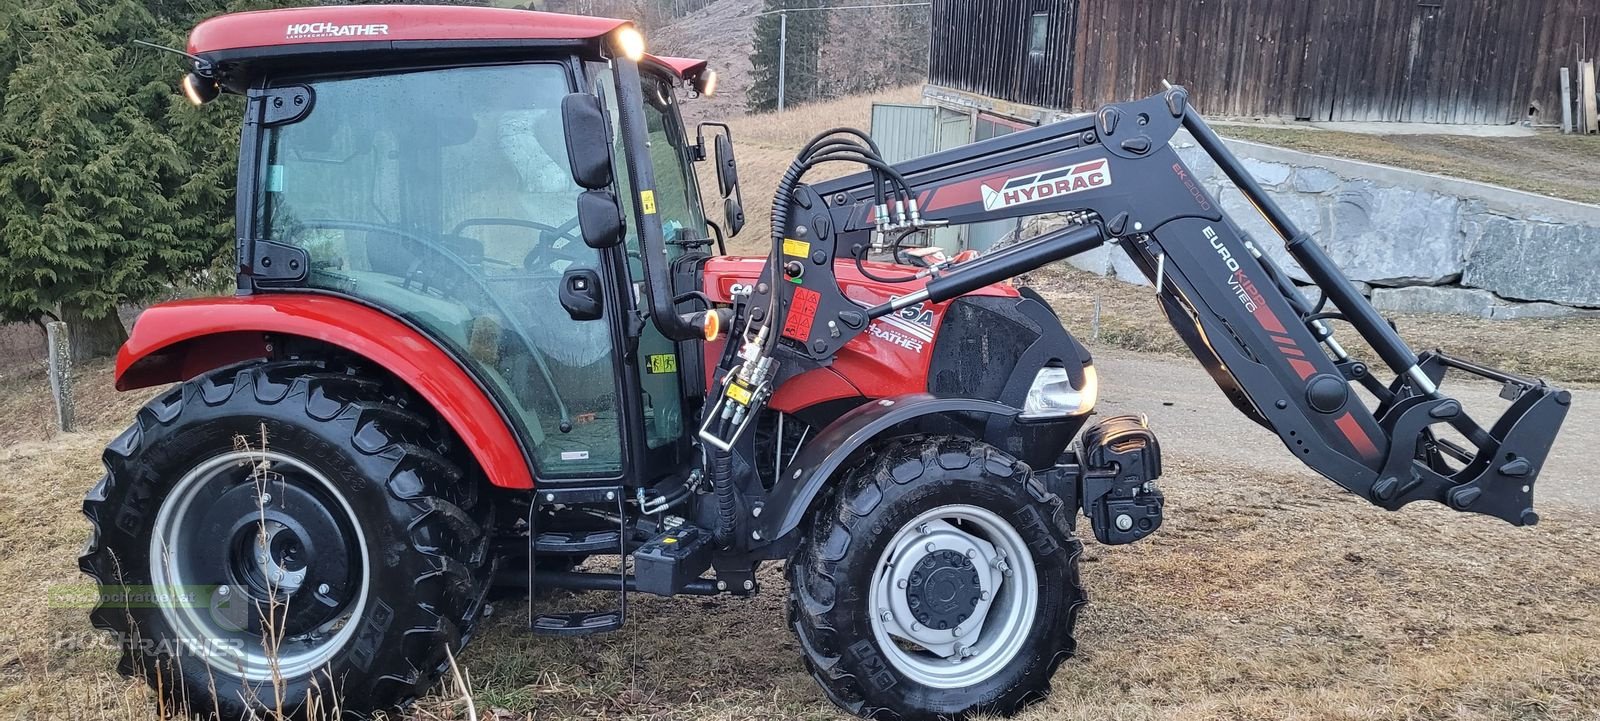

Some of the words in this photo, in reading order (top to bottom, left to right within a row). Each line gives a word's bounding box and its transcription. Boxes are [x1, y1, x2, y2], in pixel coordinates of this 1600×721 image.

[287, 23, 389, 36] HOCHRATHER
[1003, 172, 1105, 205] HYDRAC
[1202, 226, 1266, 307] EUROKIPP
[848, 639, 898, 692] BKT
